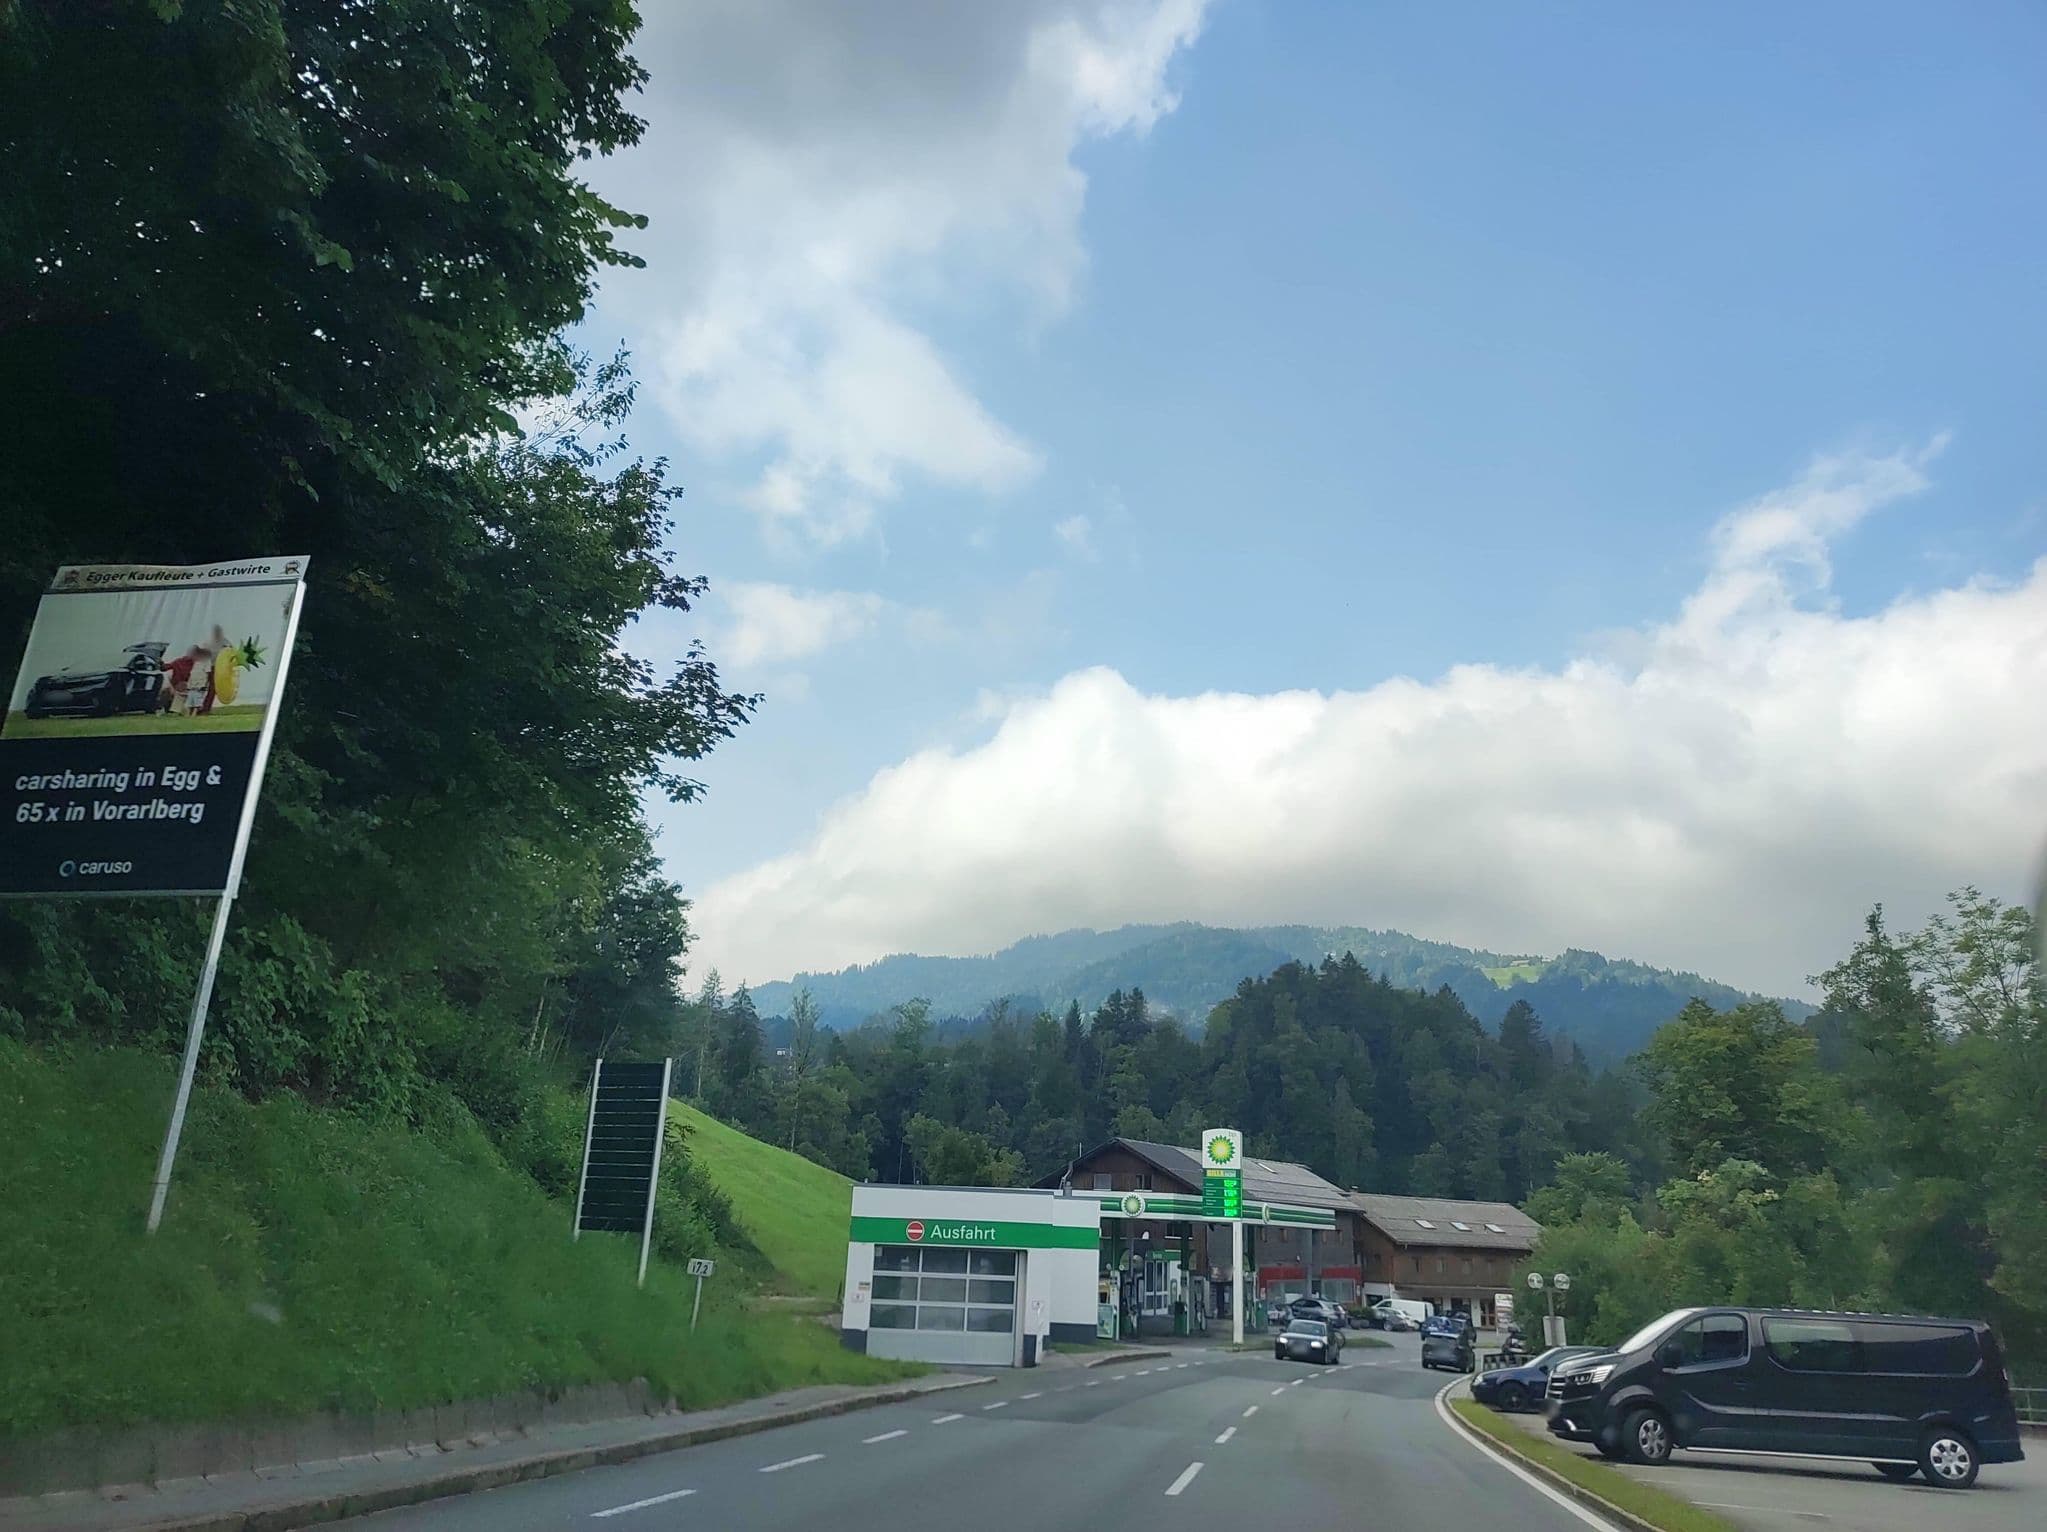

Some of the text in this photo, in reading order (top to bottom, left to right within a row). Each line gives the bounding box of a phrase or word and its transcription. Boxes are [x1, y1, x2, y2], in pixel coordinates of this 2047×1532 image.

[86, 570, 126, 584] Egger
[127, 568, 194, 581] Kaufleute
[208, 564, 271, 578] Gastwirte
[15, 765, 222, 792] carsharing in Egg &
[65, 801, 86, 821] in
[93, 799, 205, 824] Vorarlberg
[79, 860, 132, 874] caruso
[930, 1224, 996, 1240] Ausfahrt
